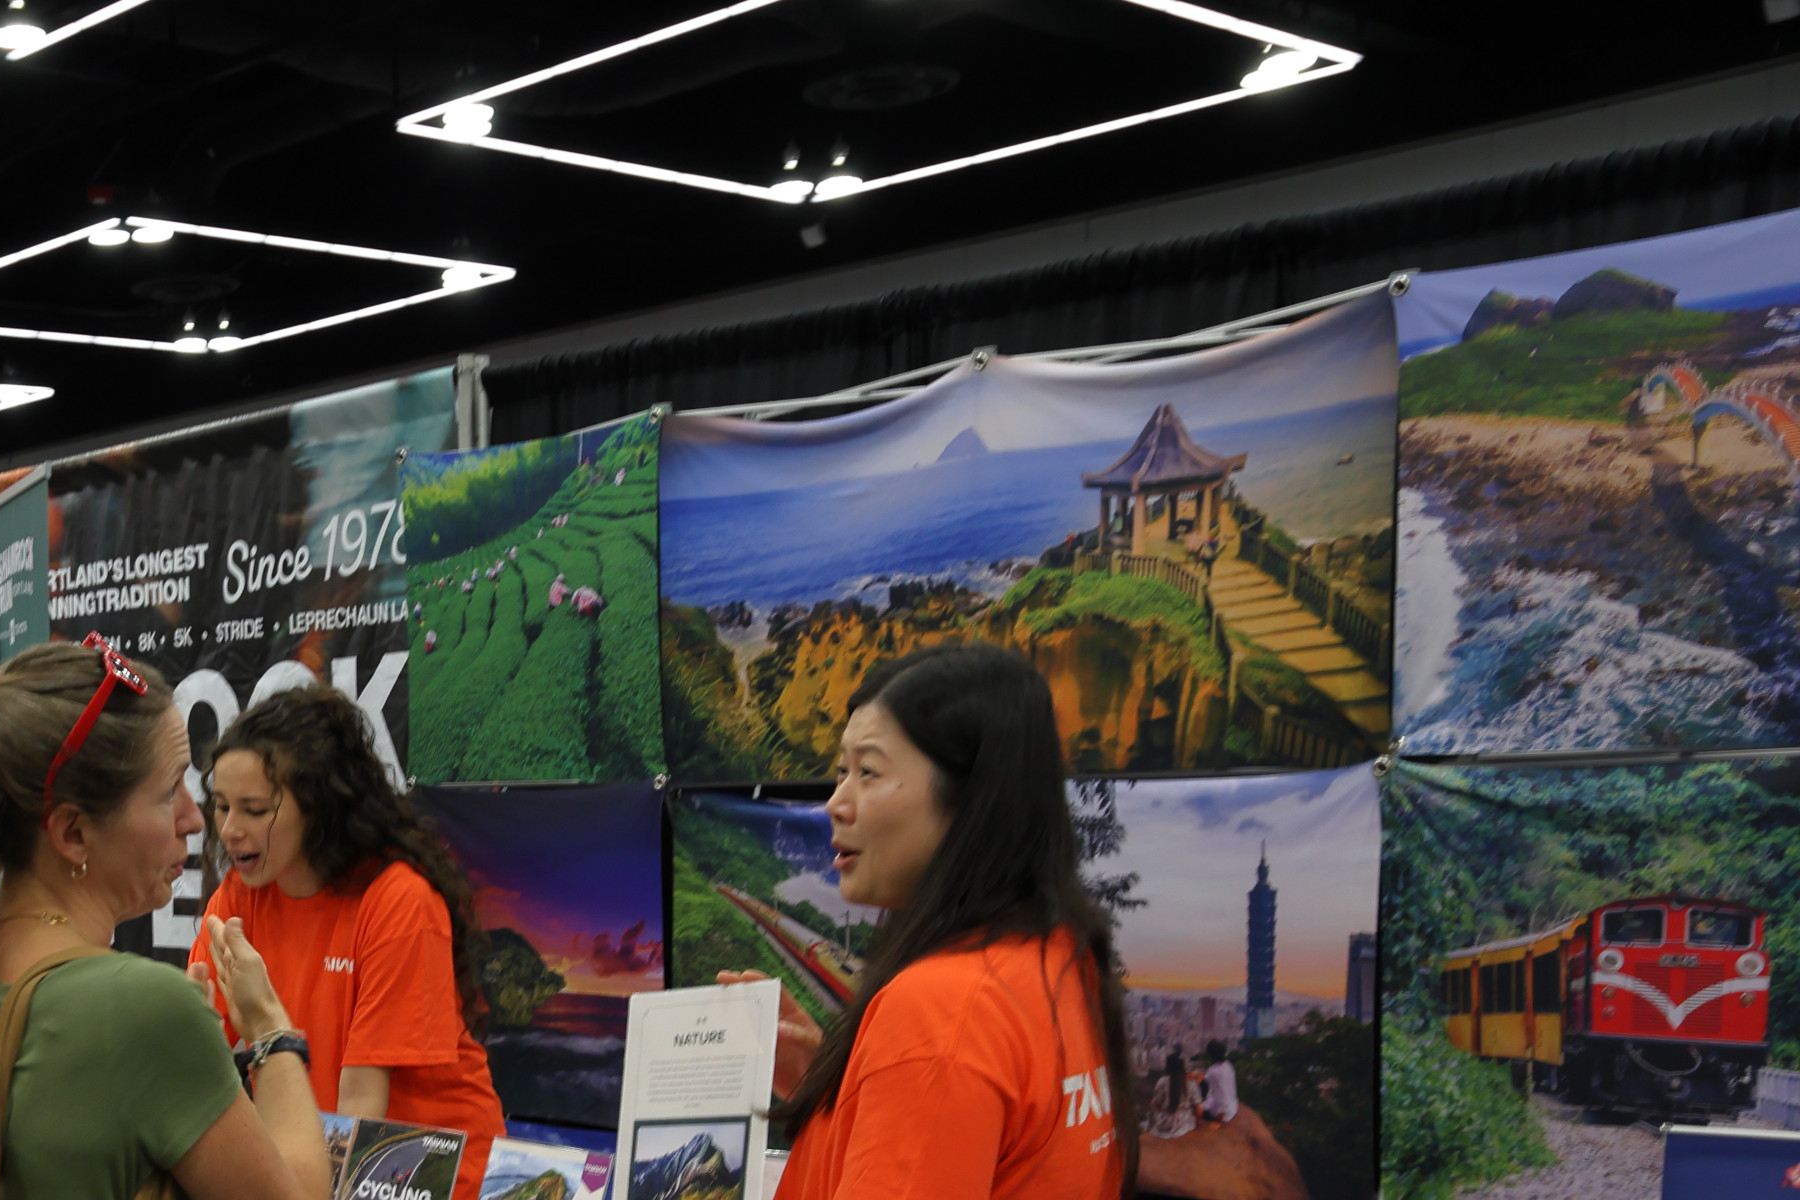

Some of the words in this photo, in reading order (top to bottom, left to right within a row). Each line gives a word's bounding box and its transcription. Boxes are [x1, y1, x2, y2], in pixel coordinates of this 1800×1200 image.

[48, 558, 125, 592] RTLAND'S
[126, 542, 209, 580] LONGEST
[222, 538, 314, 605] Since
[48, 590, 96, 620] NNING
[96, 576, 191, 614] TRADITION
[138, 630, 157, 653] 8K
[173, 626, 193, 648] 5K
[215, 616, 265, 644] STRIDE
[288, 603, 391, 635] LEPRECHAUN
[391, 599, 409, 623] LA
[673, 1029, 728, 1048] NATURE
[422, 1135, 459, 1152] TAIWAN
